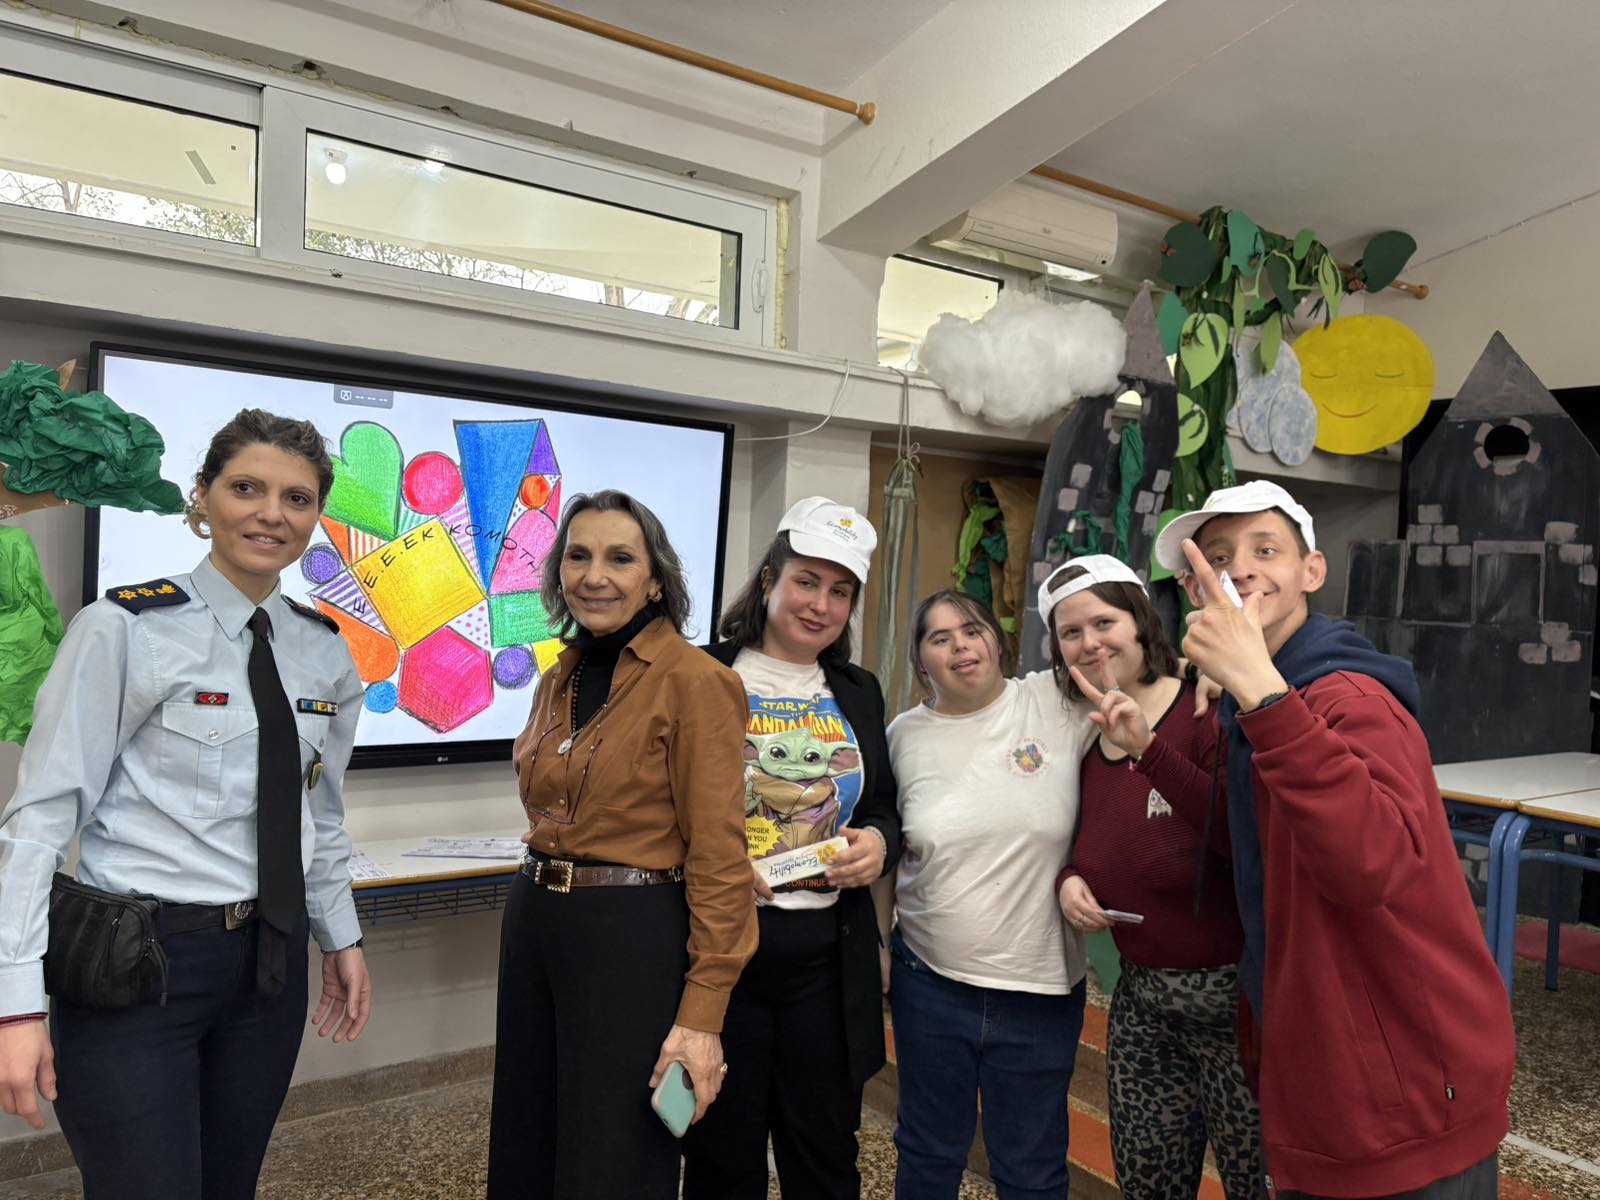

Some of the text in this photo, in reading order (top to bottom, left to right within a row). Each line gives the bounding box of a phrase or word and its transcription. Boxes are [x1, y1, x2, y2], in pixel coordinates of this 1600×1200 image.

[759, 701, 797, 711] STAR
[747, 826, 770, 834] ONGER
[785, 879, 828, 888] CONTINUE
